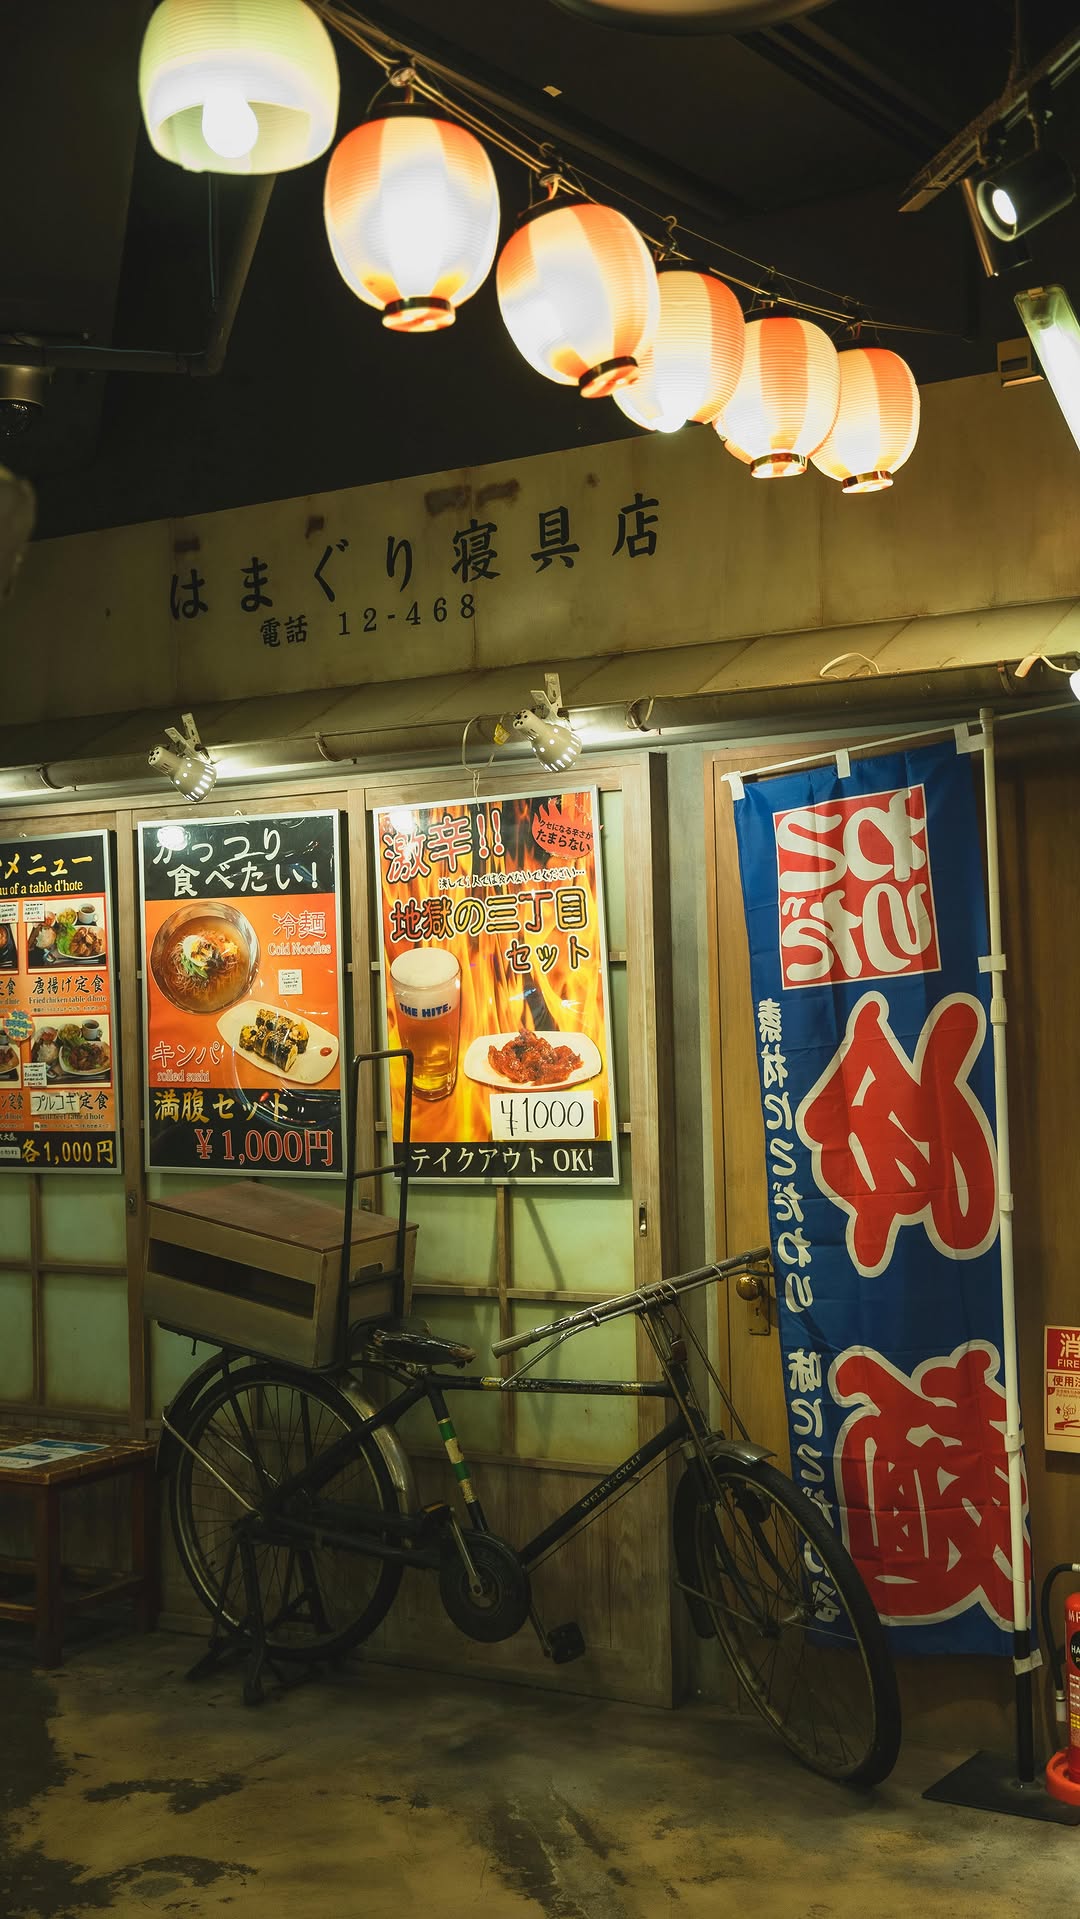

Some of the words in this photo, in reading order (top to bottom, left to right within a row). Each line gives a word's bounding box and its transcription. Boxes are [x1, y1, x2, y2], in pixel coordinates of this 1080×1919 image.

[169, 492, 660, 620] はまぐり寝具店
[259, 614, 308, 648] 電話
[338, 593, 477, 636] 12-468
[536, 829, 591, 852] たまらない
[0, 852, 93, 880] メニュー
[166, 861, 318, 897] 食べたい!
[10, 882, 20, 895] of
[21, 885, 27, 894] a
[29, 880, 53, 894] table
[390, 886, 589, 943] 地獄の三丁目
[268, 941, 291, 956] Cold
[291, 941, 331, 956] Noodles
[505, 935, 591, 975] セット
[32, 974, 104, 995] 唐揚げ定食
[400, 1002, 418, 1018] THE
[151, 1040, 221, 1068] キンパ
[154, 1089, 289, 1124] 満腹セット
[22, 1138, 114, 1165] 各1,000円
[410, 1147, 544, 1173] テイクアウト
[552, 1148, 594, 1172] OK!
[1057, 1358, 1080, 1369] FIRE
